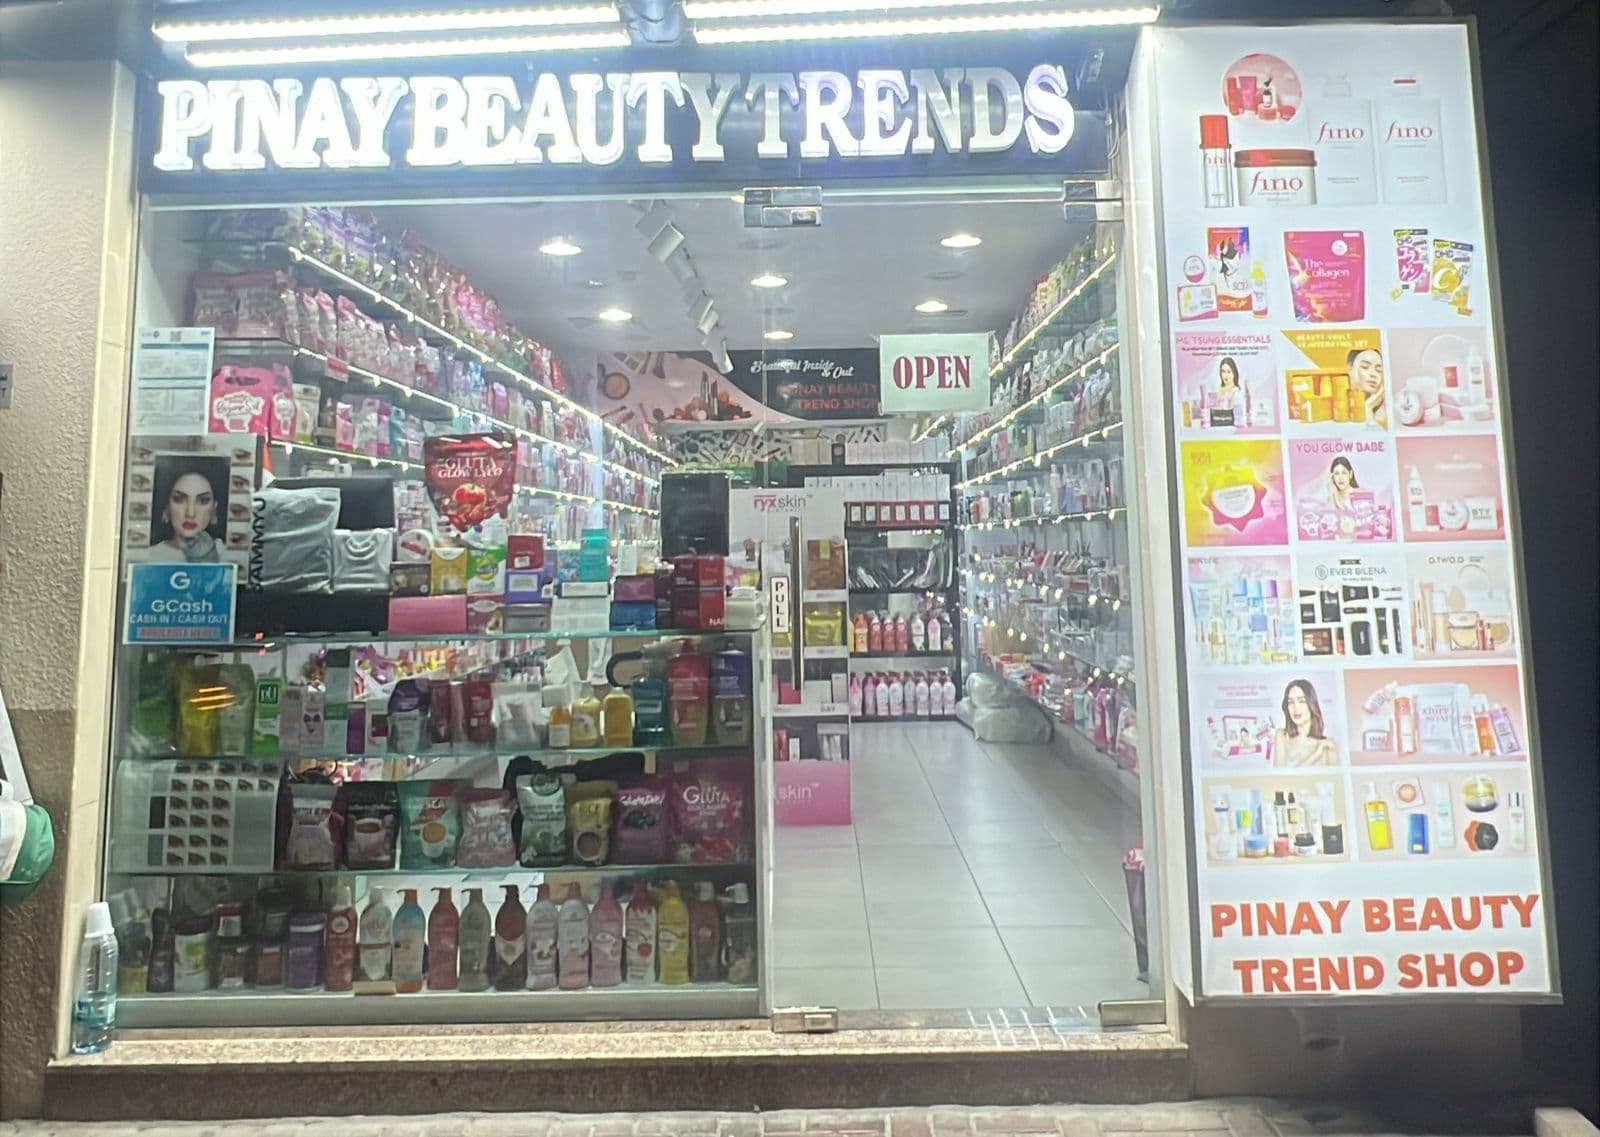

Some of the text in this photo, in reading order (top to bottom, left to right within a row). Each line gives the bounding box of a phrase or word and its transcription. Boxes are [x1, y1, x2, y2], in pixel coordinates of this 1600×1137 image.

[153, 64, 1075, 172] PINAY BEAUTY TRENDS
[1315, 121, 1364, 145] fino
[1384, 121, 1433, 144] fino
[1248, 171, 1303, 196] fino
[803, 359, 835, 372] Inside
[832, 366, 855, 379] Out
[893, 355, 972, 389] OPEN
[1296, 441, 1385, 454] YOU GLOW BABE
[444, 456, 497, 472] GLUTA
[1330, 567, 1353, 577] EVER
[151, 598, 213, 613] GCash
[774, 581, 786, 629] PULL
[1211, 894, 1540, 938] PINAY BEAUTY
[1233, 951, 1525, 993] TREND SHOP
